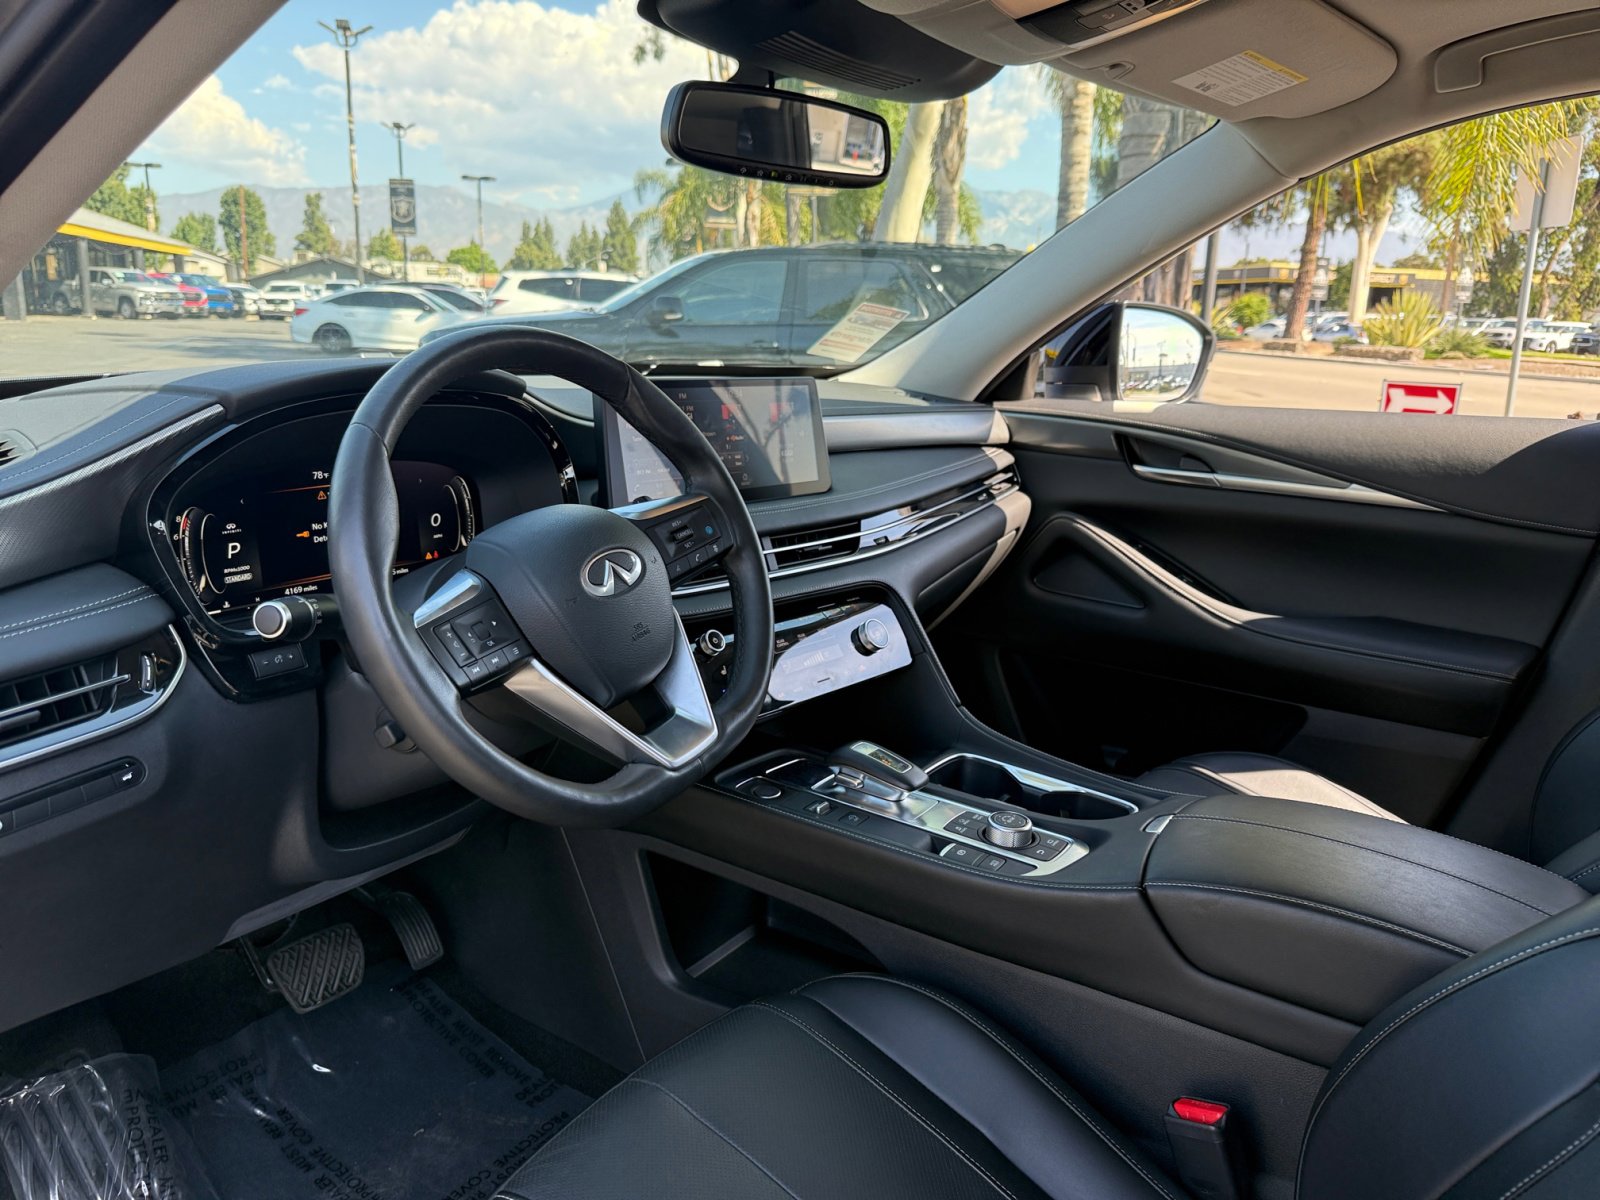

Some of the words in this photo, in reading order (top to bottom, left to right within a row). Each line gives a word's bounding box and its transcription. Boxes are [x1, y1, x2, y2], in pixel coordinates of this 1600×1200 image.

[175, 515, 182, 523] 8
[311, 523, 323, 531] No
[173, 533, 179, 541] 6
[227, 542, 241, 559] P
[284, 585, 303, 596] 4169
[303, 585, 318, 593] miles
[276, 1107, 313, 1145] COVER
[492, 1111, 571, 1169] PROTECTIVE
